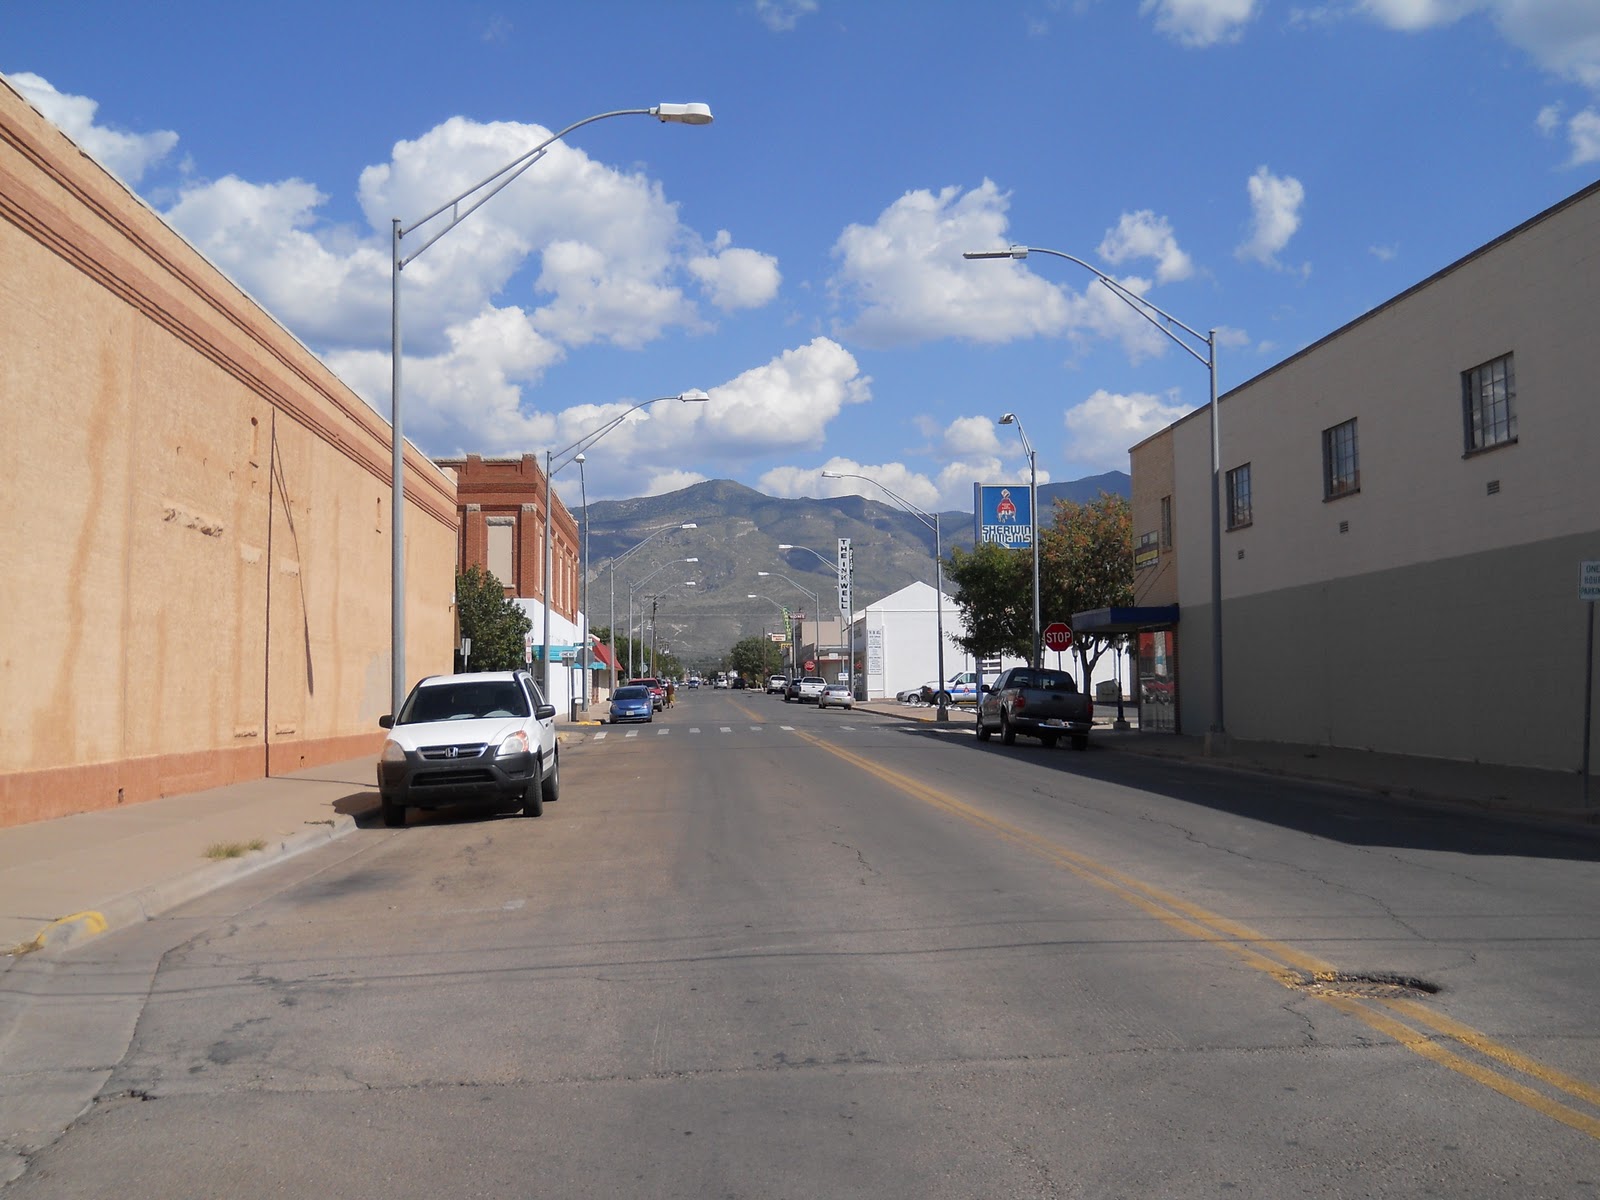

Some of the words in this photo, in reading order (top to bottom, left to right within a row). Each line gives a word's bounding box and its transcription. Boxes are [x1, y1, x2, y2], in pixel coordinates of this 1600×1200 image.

[982, 525, 1031, 534] SHERWIN
[1586, 565, 1600, 573] ONE
[1046, 632, 1070, 643] STOP
